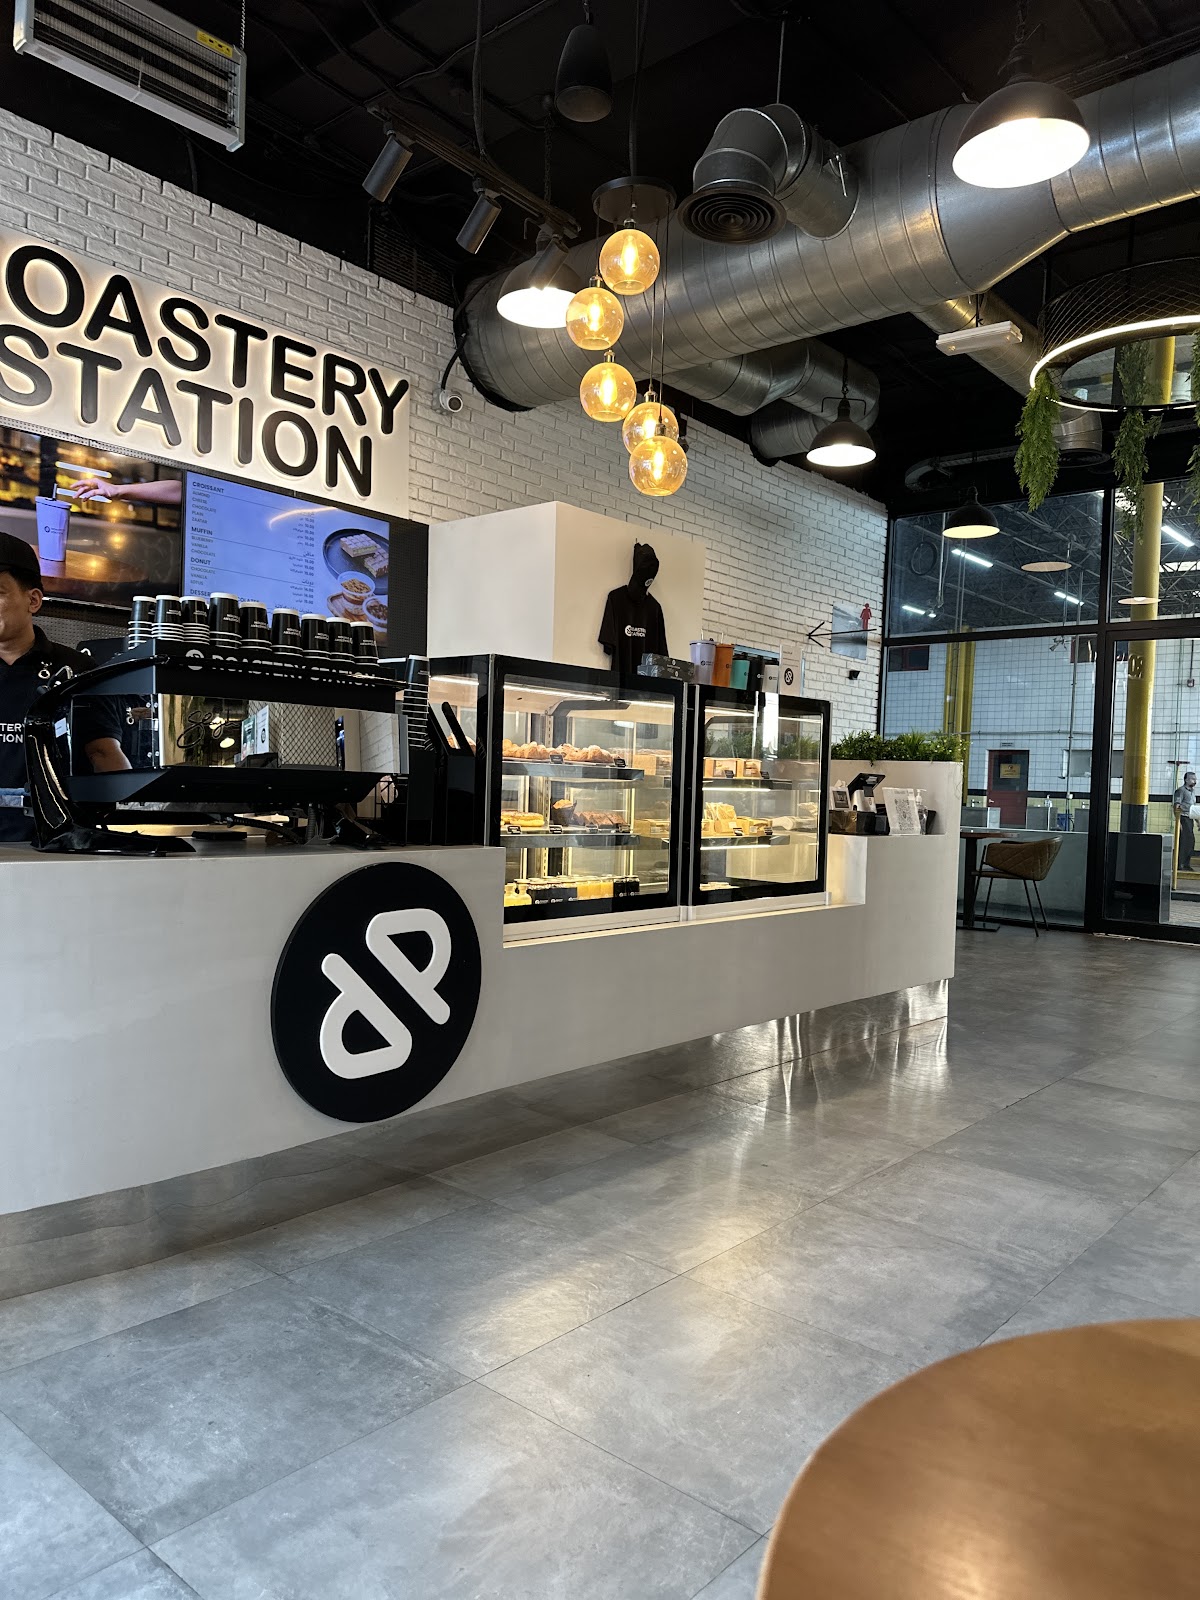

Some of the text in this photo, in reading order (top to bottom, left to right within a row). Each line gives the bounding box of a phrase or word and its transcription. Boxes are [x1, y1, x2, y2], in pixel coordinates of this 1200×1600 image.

[5, 245, 409, 435] OASTERY
[0, 324, 372, 498] STATION
[192, 481, 224, 493] CROISSANT
[191, 527, 213, 535] MUFFIN
[190, 557, 211, 565] DONUT
